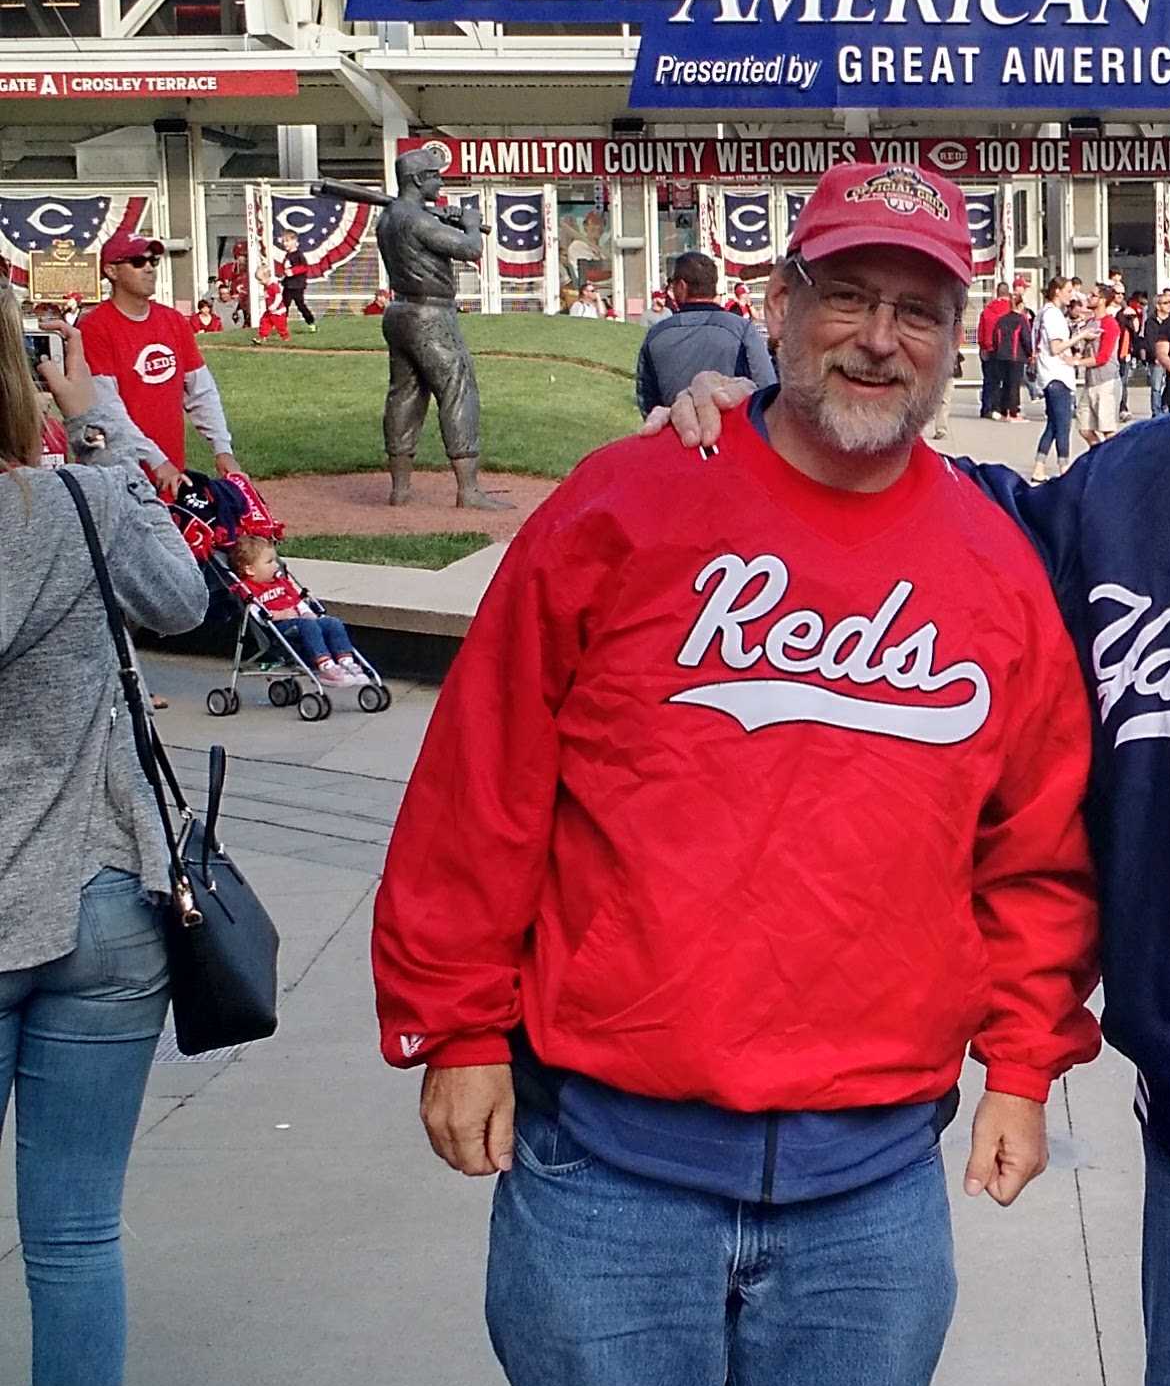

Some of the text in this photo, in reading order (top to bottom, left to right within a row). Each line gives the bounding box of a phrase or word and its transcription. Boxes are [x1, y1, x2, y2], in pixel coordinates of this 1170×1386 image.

[0, 73, 217, 95] GATE A CROSLEY TERRACE
[656, 53, 783, 85] Presented
[787, 53, 820, 91] by
[838, 45, 981, 84] GREAT
[460, 141, 593, 174] HAMILTON
[604, 141, 706, 173] COUNTY
[716, 141, 857, 173] WELCOMES
[871, 141, 920, 167] YOU
[939, 149, 968, 161] REDS
[975, 140, 1021, 172] 100
[1029, 140, 1071, 172] JOE
[144, 355, 177, 371] REDS
[677, 553, 988, 694] Reds
